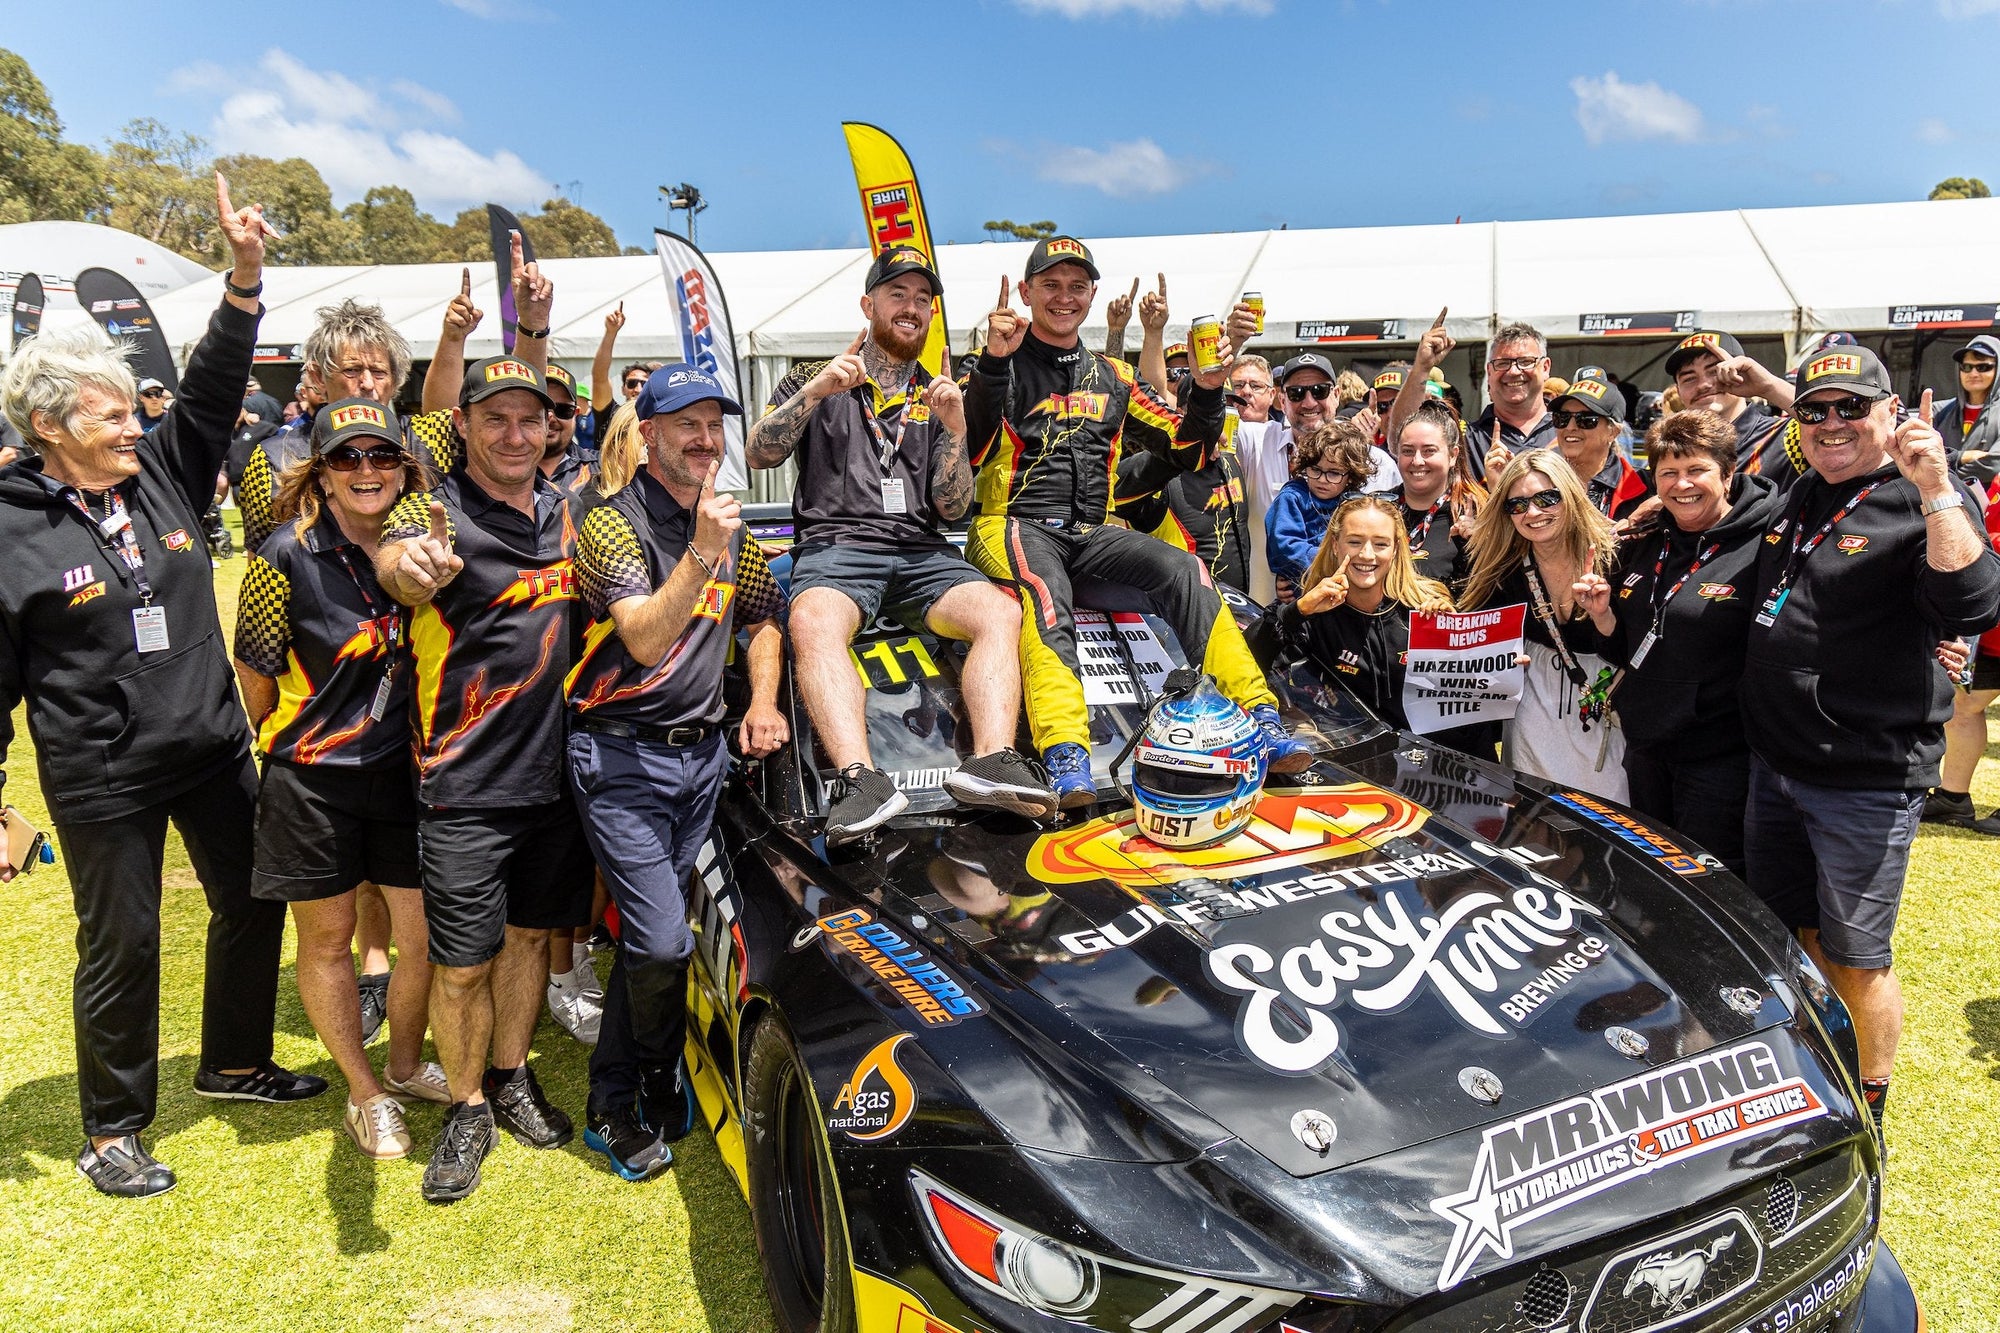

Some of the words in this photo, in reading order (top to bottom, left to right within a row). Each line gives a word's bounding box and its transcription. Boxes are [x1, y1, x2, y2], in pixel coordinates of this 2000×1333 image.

[872, 187, 907, 206] HIRE
[1049, 240, 1082, 255] TFH
[1583, 318, 1633, 330] BAILEY
[1674, 312, 1695, 328] 12
[1893, 309, 1964, 323] GARTNER
[1299, 325, 1350, 337] RAMSAY
[1057, 351, 1081, 363] HRX
[1810, 356, 1852, 374] TFH
[488, 360, 530, 380] TFH
[547, 366, 566, 379] FH
[1375, 372, 1397, 385] TFH
[1573, 380, 1600, 393] TFH
[1050, 393, 1094, 414] TFH
[334, 405, 380, 424] TFH
[64, 565, 95, 592] 111
[517, 569, 580, 596] TFH
[76, 588, 100, 602] TFH
[1436, 611, 1501, 630] BREAKING
[1449, 628, 1487, 647] NEWS
[1084, 646, 1123, 659] WIN
[1338, 649, 1359, 666] 111
[1080, 661, 1164, 676] TRANSAM
[1413, 652, 1518, 673] HAZELWOOD
[1440, 678, 1489, 690] WINS
[1416, 688, 1508, 700] TRANS-AM
[1437, 701, 1481, 717] TITLE
[1144, 752, 1180, 765] Border
[1224, 760, 1249, 774] TFH
[1604, 813, 1683, 854] CRANE
[1058, 895, 1212, 956] GULF
[1224, 850, 1476, 911] WESTERN
[855, 922, 982, 1015] COLLIERS
[833, 931, 906, 979] CRANE
[888, 978, 954, 1024] HIRE
[1209, 891, 1448, 1071] Easy
[1499, 950, 1588, 1023] BREWING
[832, 1083, 890, 1117] Agas
[828, 1111, 889, 1128] national
[1499, 1143, 1628, 1218] HYDRAULICS
[1628, 1132, 1662, 1167] &
[1654, 1119, 1692, 1154] TILT
[1691, 1105, 1740, 1141] TRAY
[1740, 1085, 1808, 1125] SERVICE
